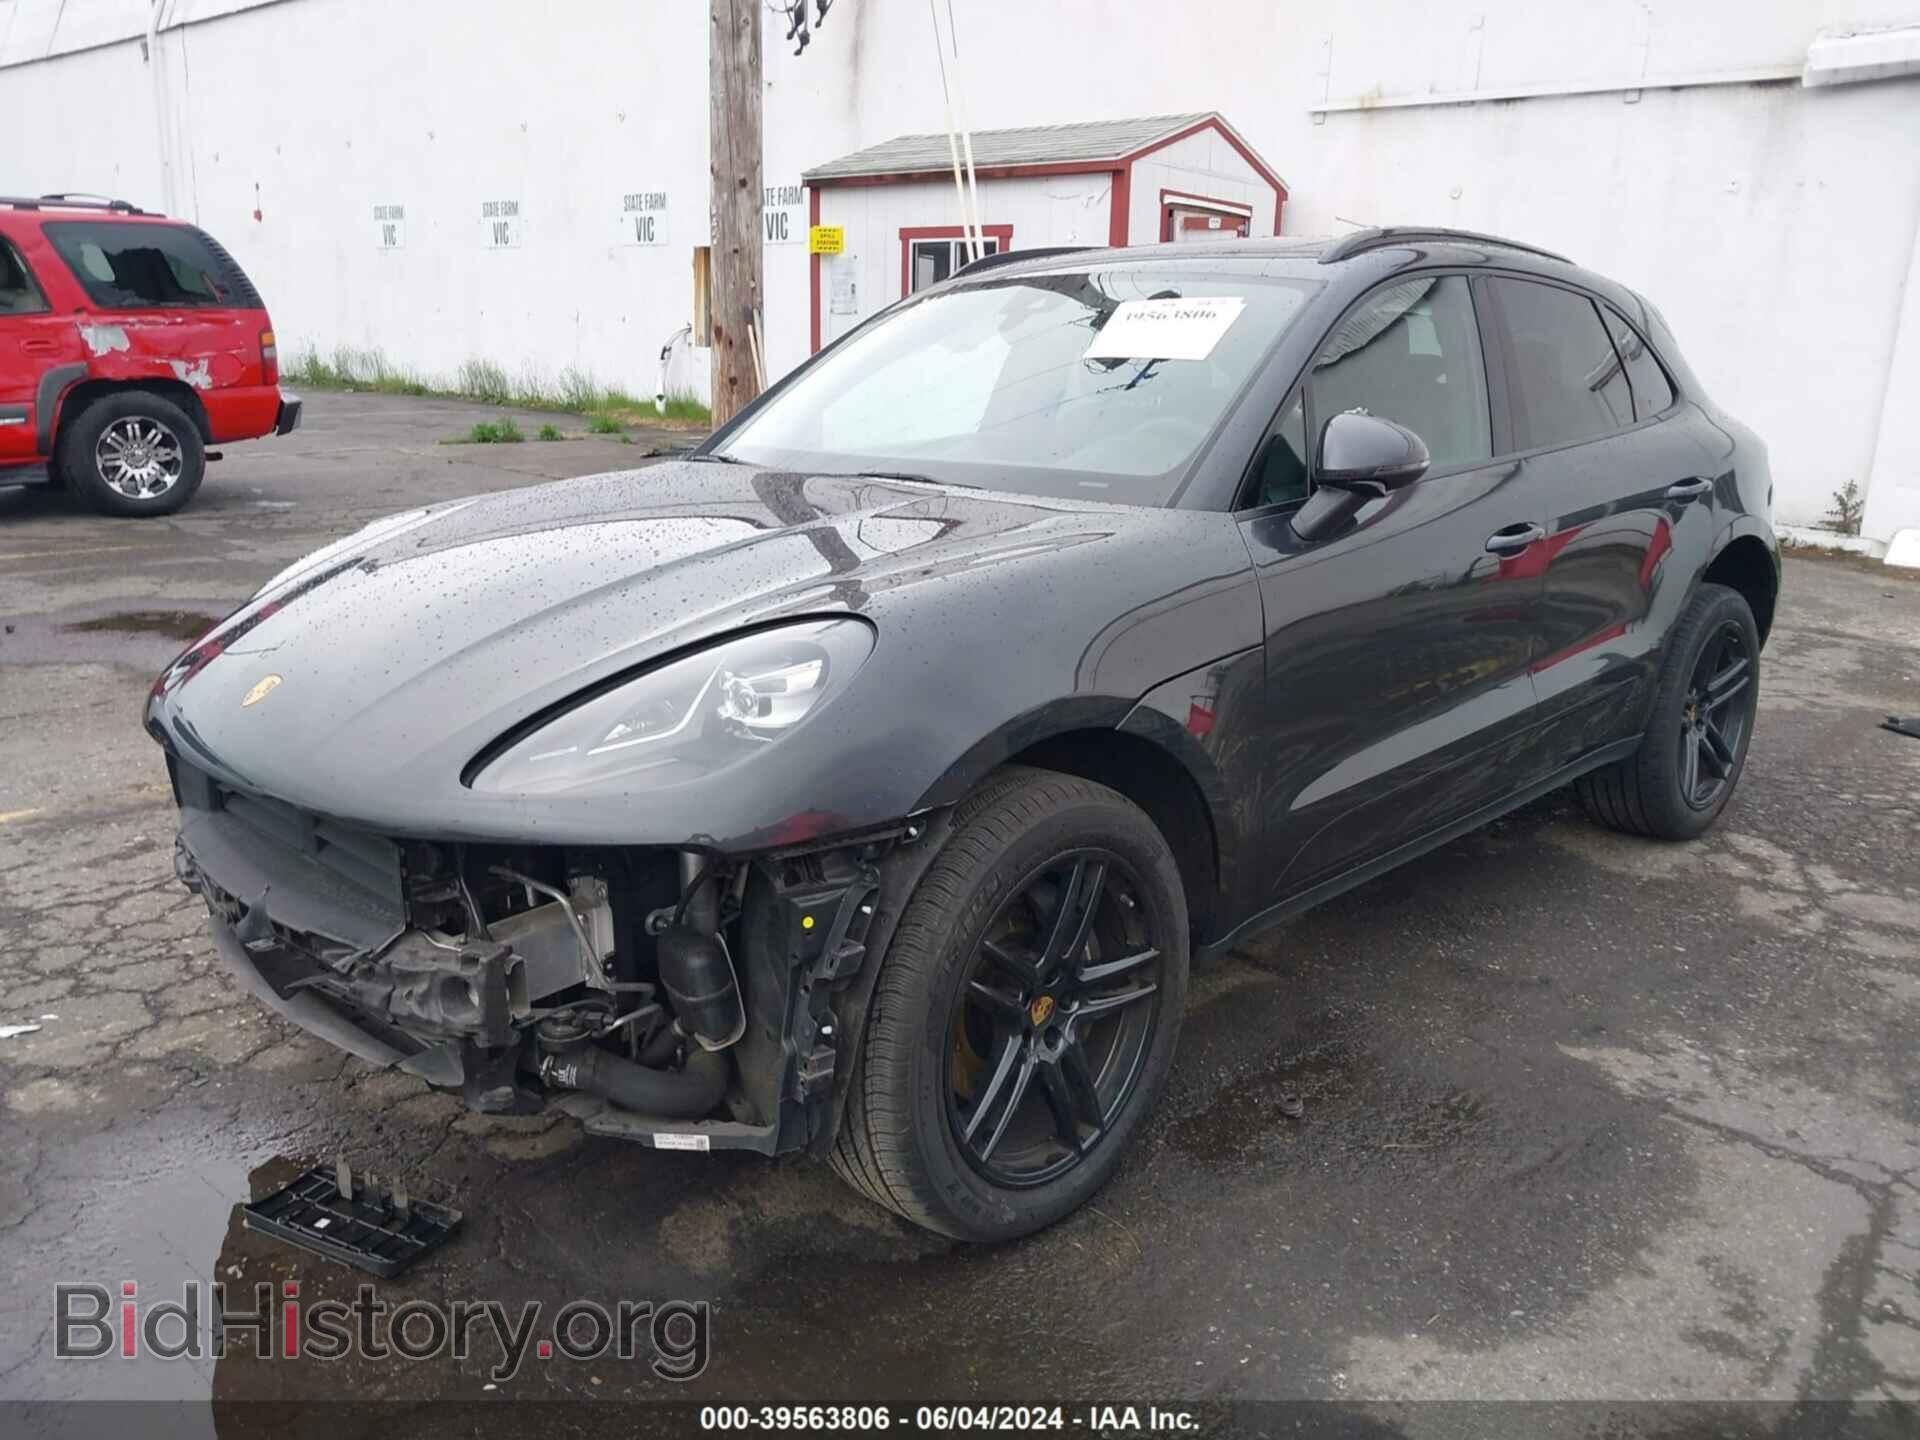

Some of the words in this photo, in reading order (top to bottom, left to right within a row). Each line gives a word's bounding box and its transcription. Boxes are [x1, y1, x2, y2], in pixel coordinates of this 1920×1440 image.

[624, 193, 643, 212] STATE
[645, 192, 666, 211] FARM
[777, 186, 803, 206] FARM
[382, 223, 397, 246] VIC
[492, 221, 509, 245] VIC
[635, 216, 655, 242] VIC
[765, 212, 788, 240] VIC
